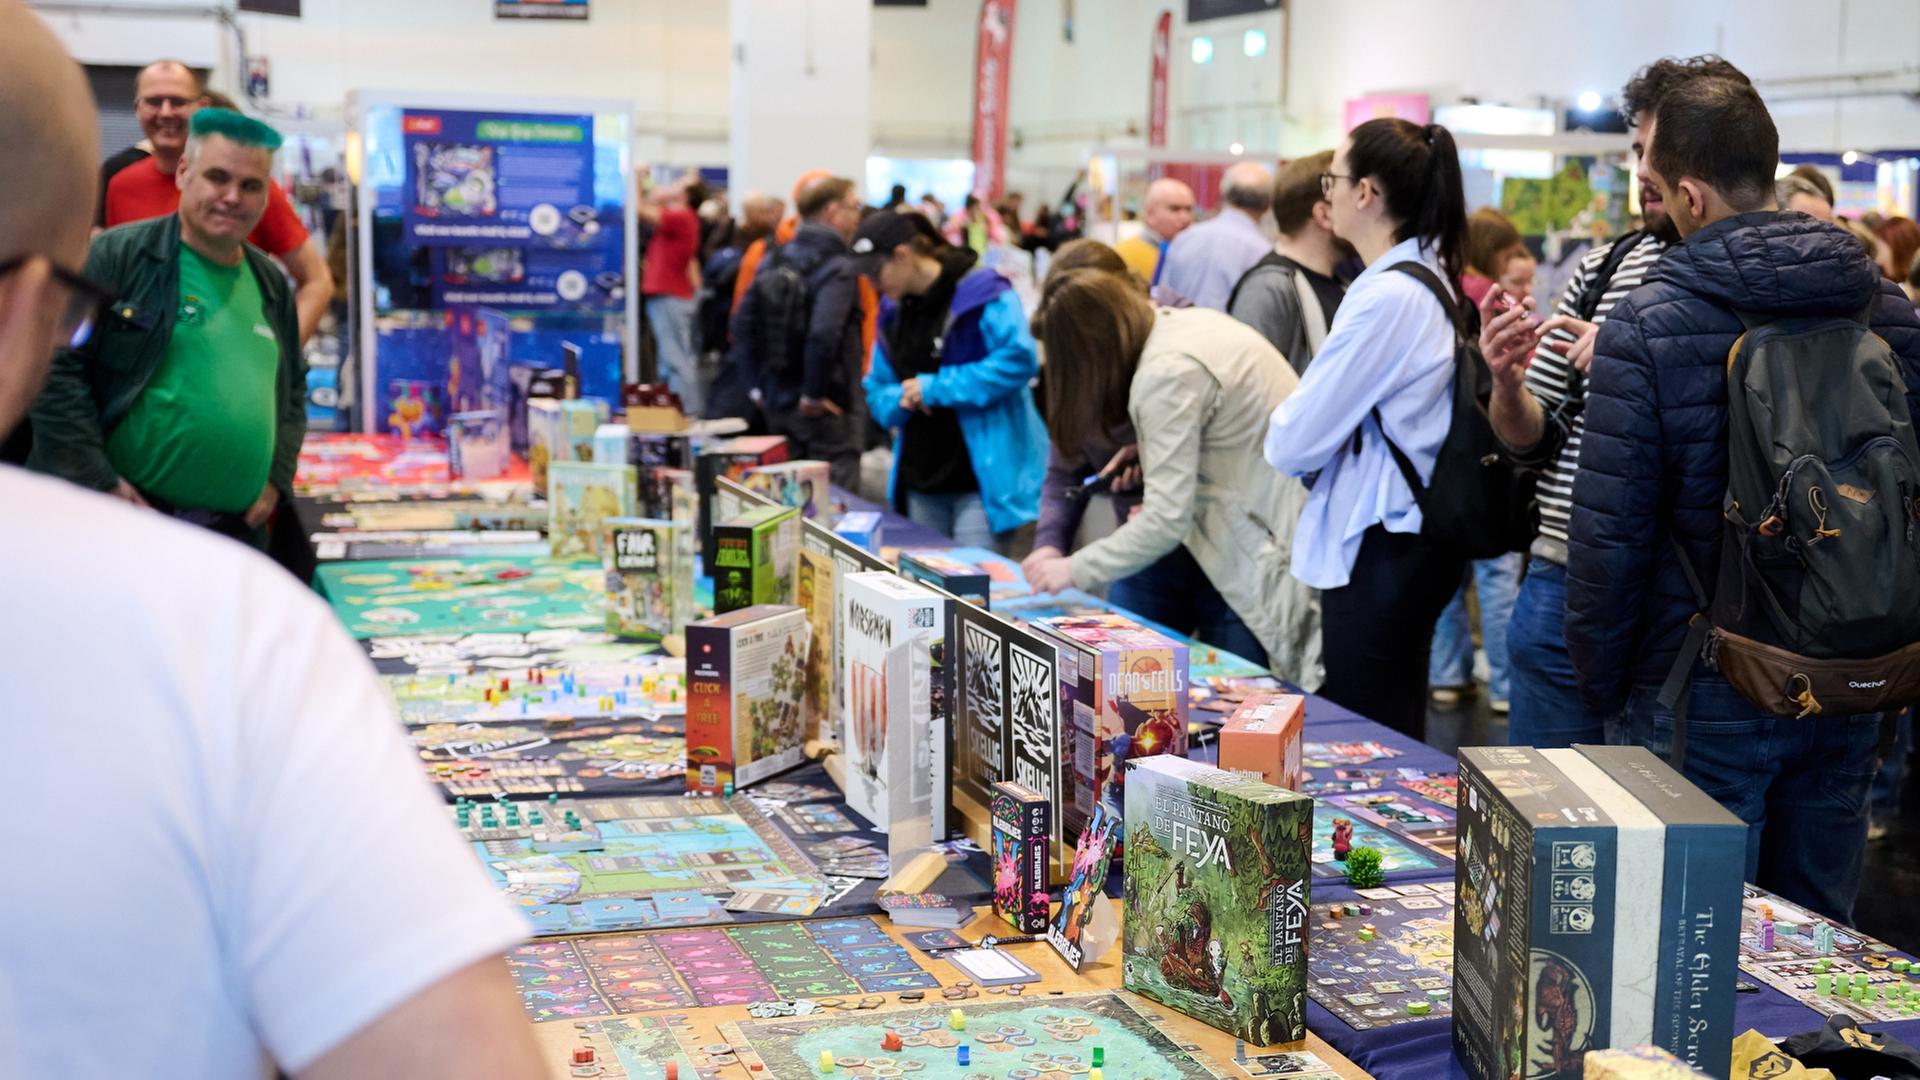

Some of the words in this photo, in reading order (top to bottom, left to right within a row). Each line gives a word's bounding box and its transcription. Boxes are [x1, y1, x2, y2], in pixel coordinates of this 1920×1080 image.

[693, 682, 720, 694] CLICK
[1109, 672, 1140, 696] DEAD
[1151, 669, 1183, 693] CELLS
[696, 711, 720, 724] TREE
[970, 727, 1001, 771] SKELLIG
[1016, 756, 1050, 802] SKELLIG
[1155, 797, 1170, 812] EL
[1172, 801, 1231, 833] PANTANO
[1155, 815, 1172, 833] DE
[1172, 820, 1232, 870] FEYA
[1275, 884, 1285, 946] PANTANO
[1285, 879, 1307, 945] FEYA
[1695, 906, 1713, 945] The
[1275, 950, 1284, 966] EL
[1285, 946, 1293, 964] DE
[1688, 953, 1711, 1009] Elder
[1687, 1016, 1708, 1071] Scrol
